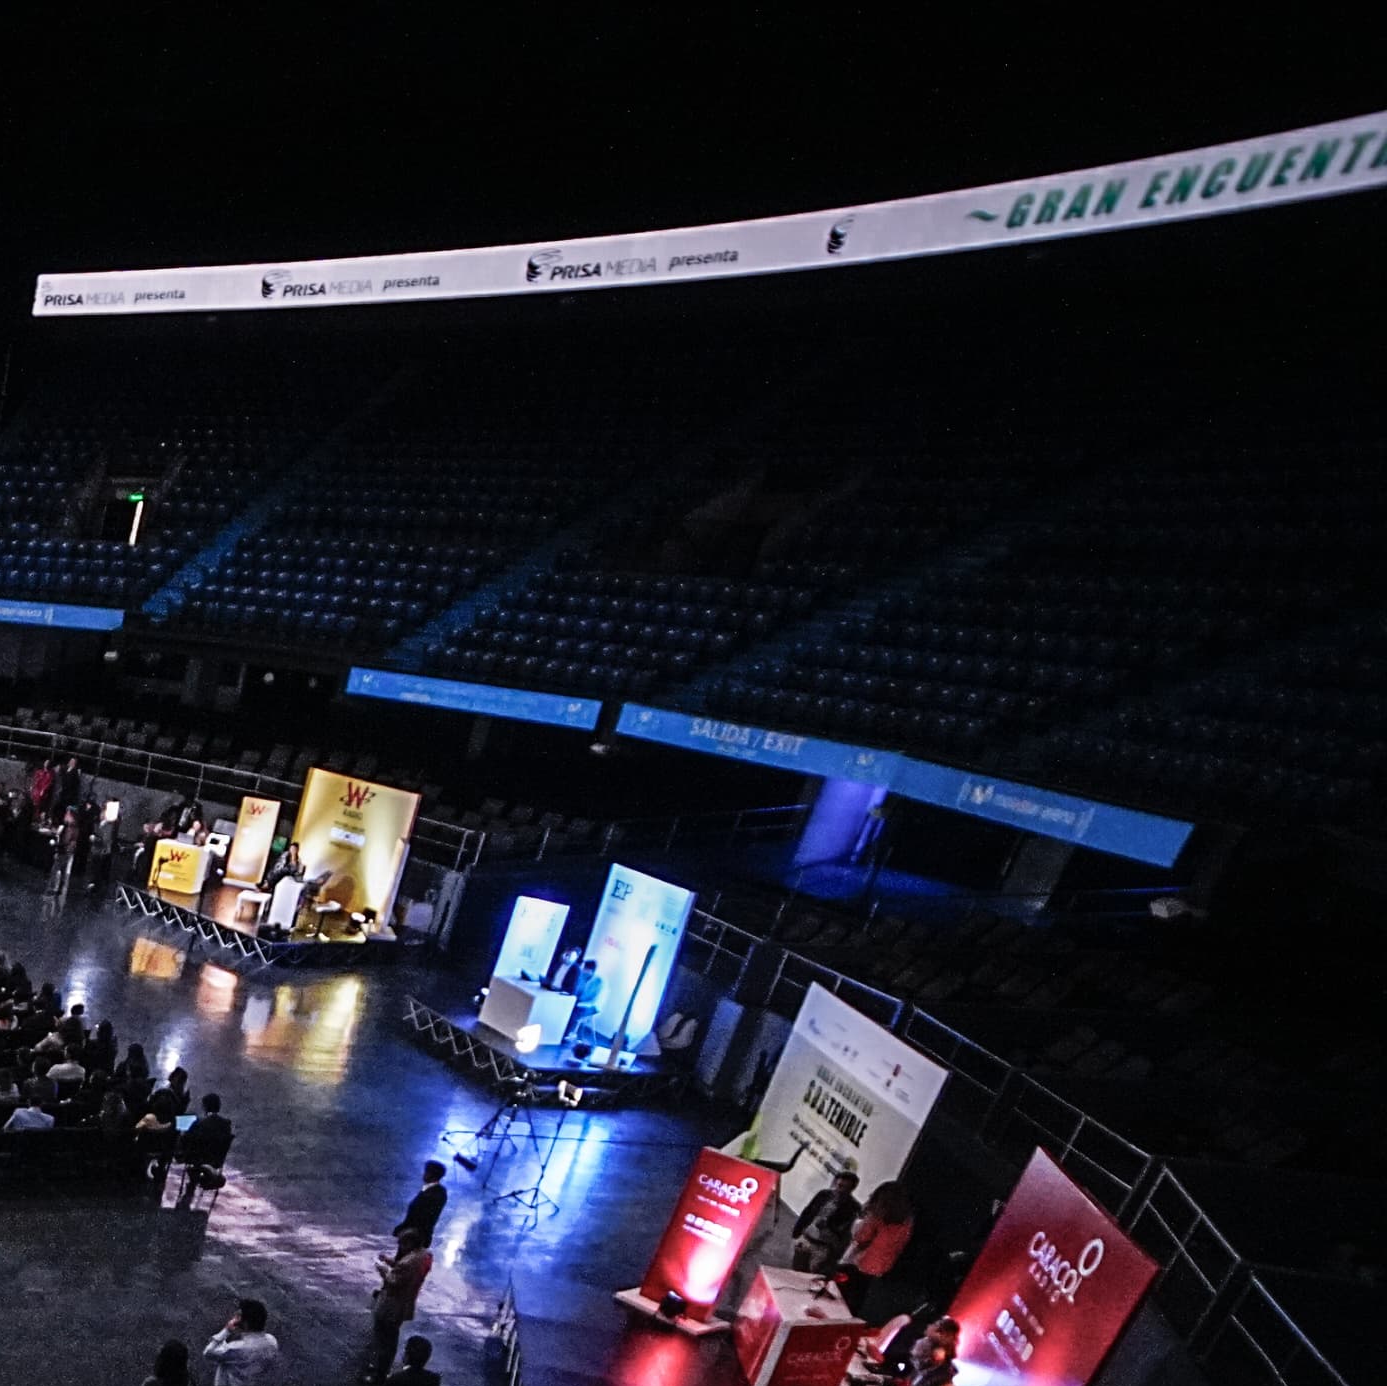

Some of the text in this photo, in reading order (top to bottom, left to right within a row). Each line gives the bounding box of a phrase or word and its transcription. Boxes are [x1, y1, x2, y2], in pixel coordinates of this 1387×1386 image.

[1006, 179, 1127, 229] GRAN
[550, 249, 739, 281] PRISA MEDIA presenta
[43, 294, 84, 307] PRISA
[133, 289, 186, 305] presenta
[282, 275, 441, 298] PRISA MEDIA presenta
[689, 717, 750, 747] SALIDA
[803, 1079, 868, 1148] SOSTENIBLE
[698, 1174, 751, 1205] CARACOL
[1029, 1231, 1082, 1305] CARACOL
